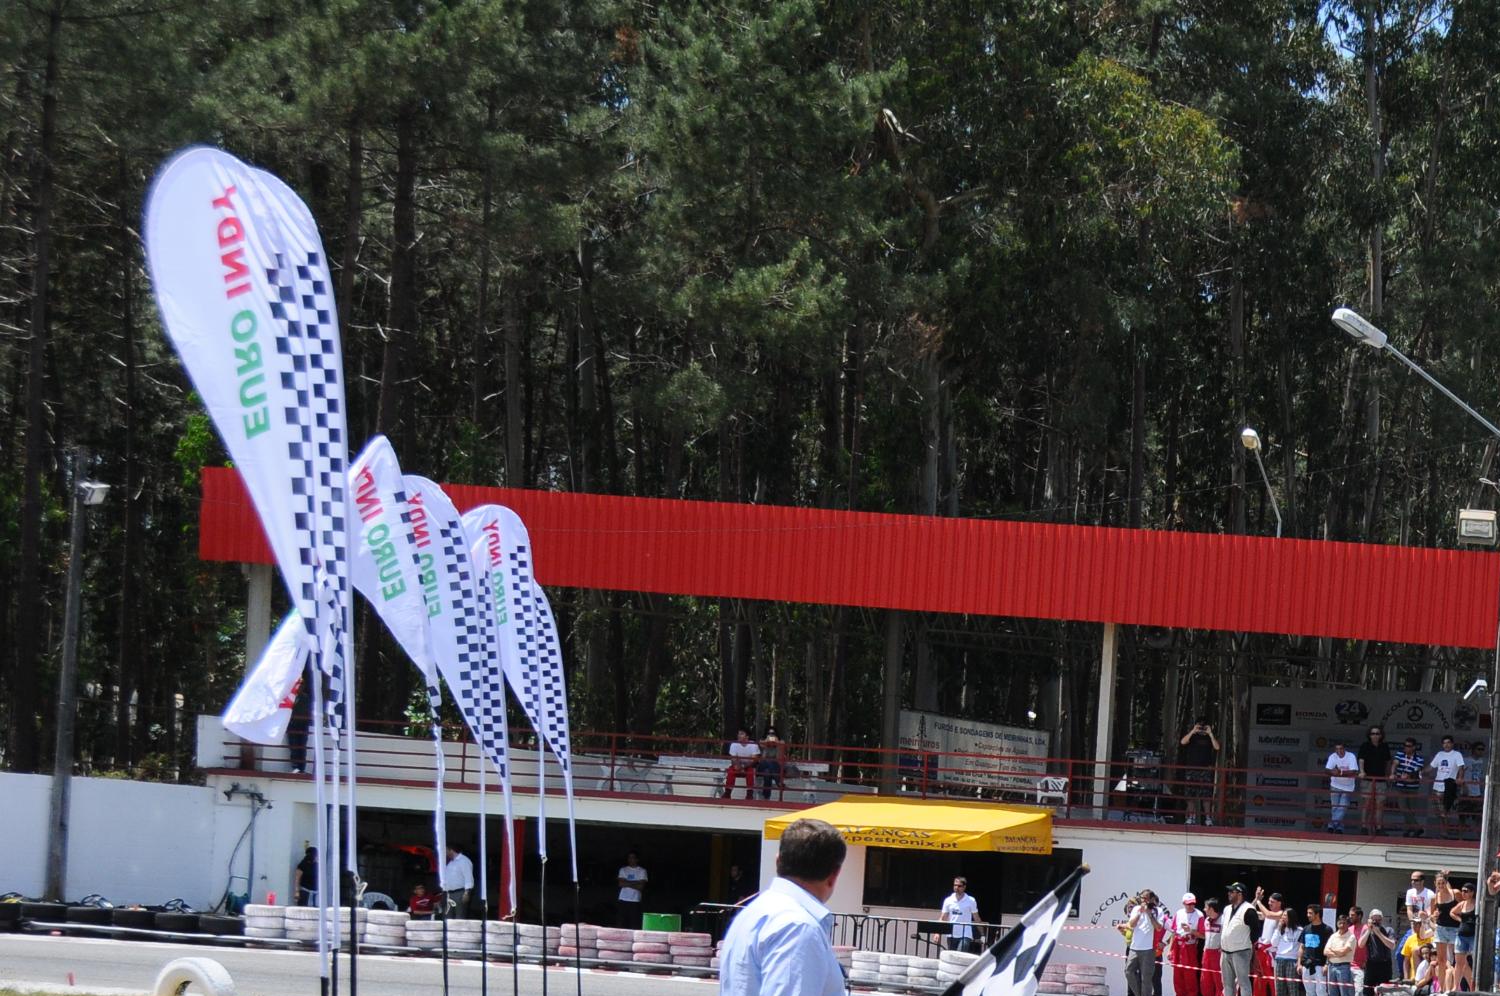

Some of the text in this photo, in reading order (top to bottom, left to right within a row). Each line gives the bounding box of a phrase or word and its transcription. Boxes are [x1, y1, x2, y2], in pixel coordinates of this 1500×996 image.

[1337, 702, 1361, 714] 24
[1382, 698, 1450, 730] SCOLA KARTING
[934, 722, 954, 733] FUROS
[960, 728, 994, 738] SONDAGENS
[994, 731, 1003, 739] DE
[1396, 722, 1434, 730] EUROINDY
[1263, 753, 1293, 765] HELIX
[1090, 891, 1128, 926] ESCOLA
